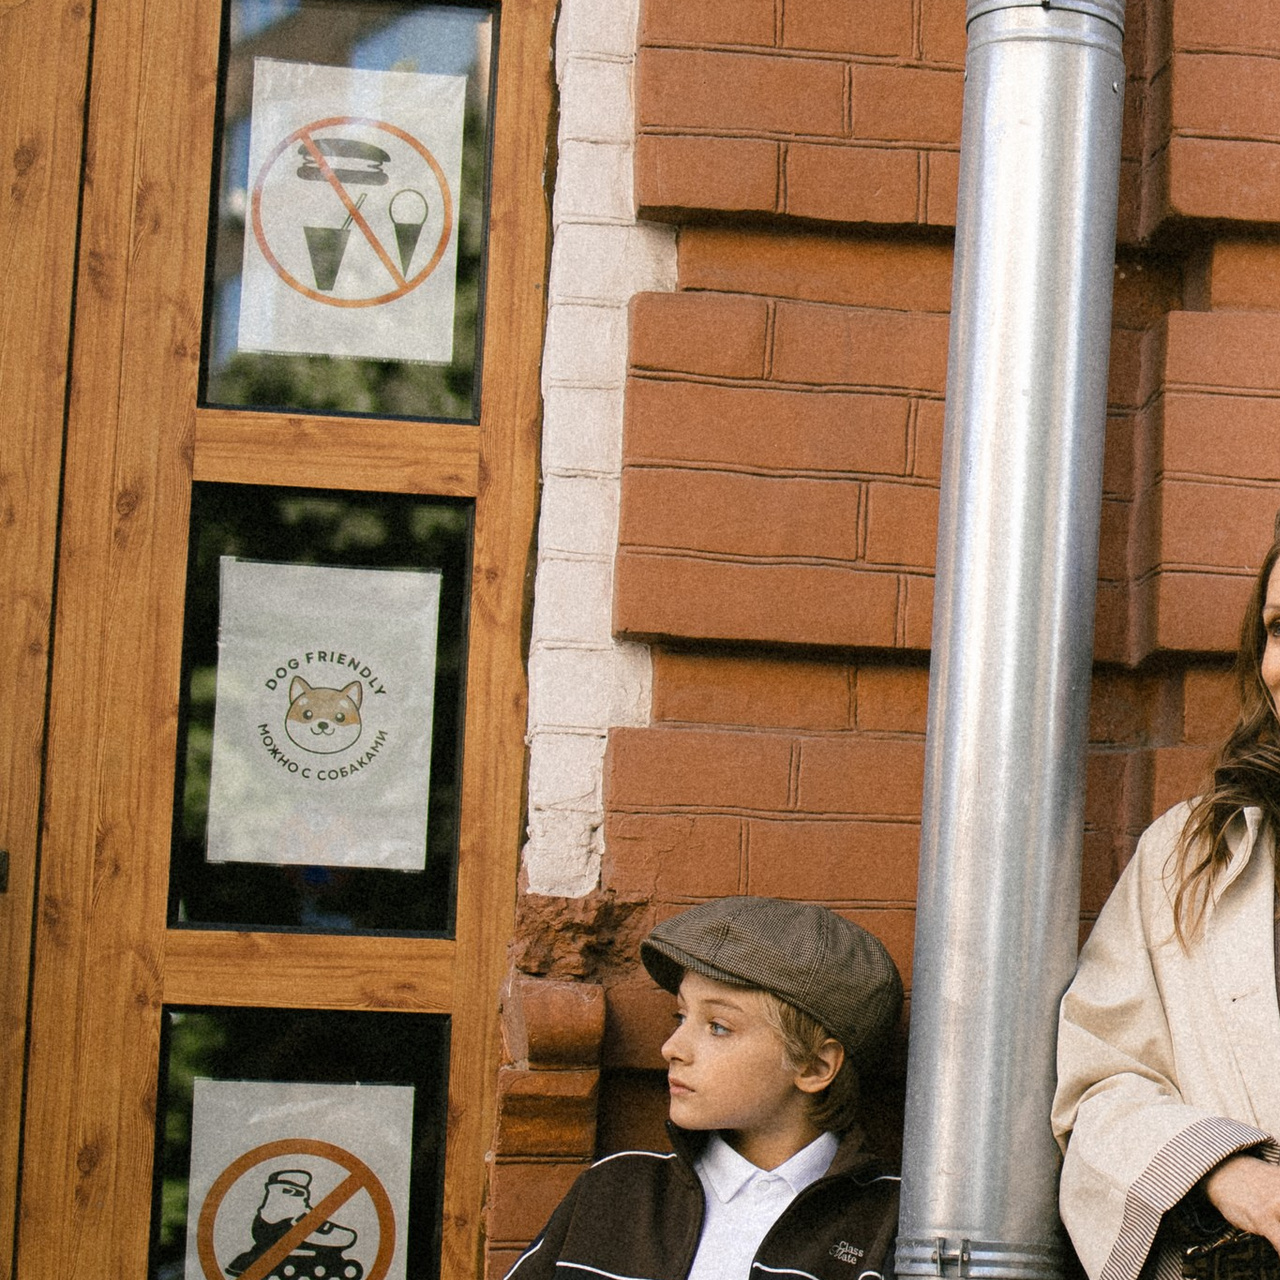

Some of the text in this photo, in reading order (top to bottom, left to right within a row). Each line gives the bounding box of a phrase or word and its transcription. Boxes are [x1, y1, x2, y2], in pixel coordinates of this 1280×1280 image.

[265, 650, 387, 695] DOG FRIENDLY
[258, 723, 388, 781] МОЖНО С СОБАКАМИ
[839, 1240, 864, 1258] Class
